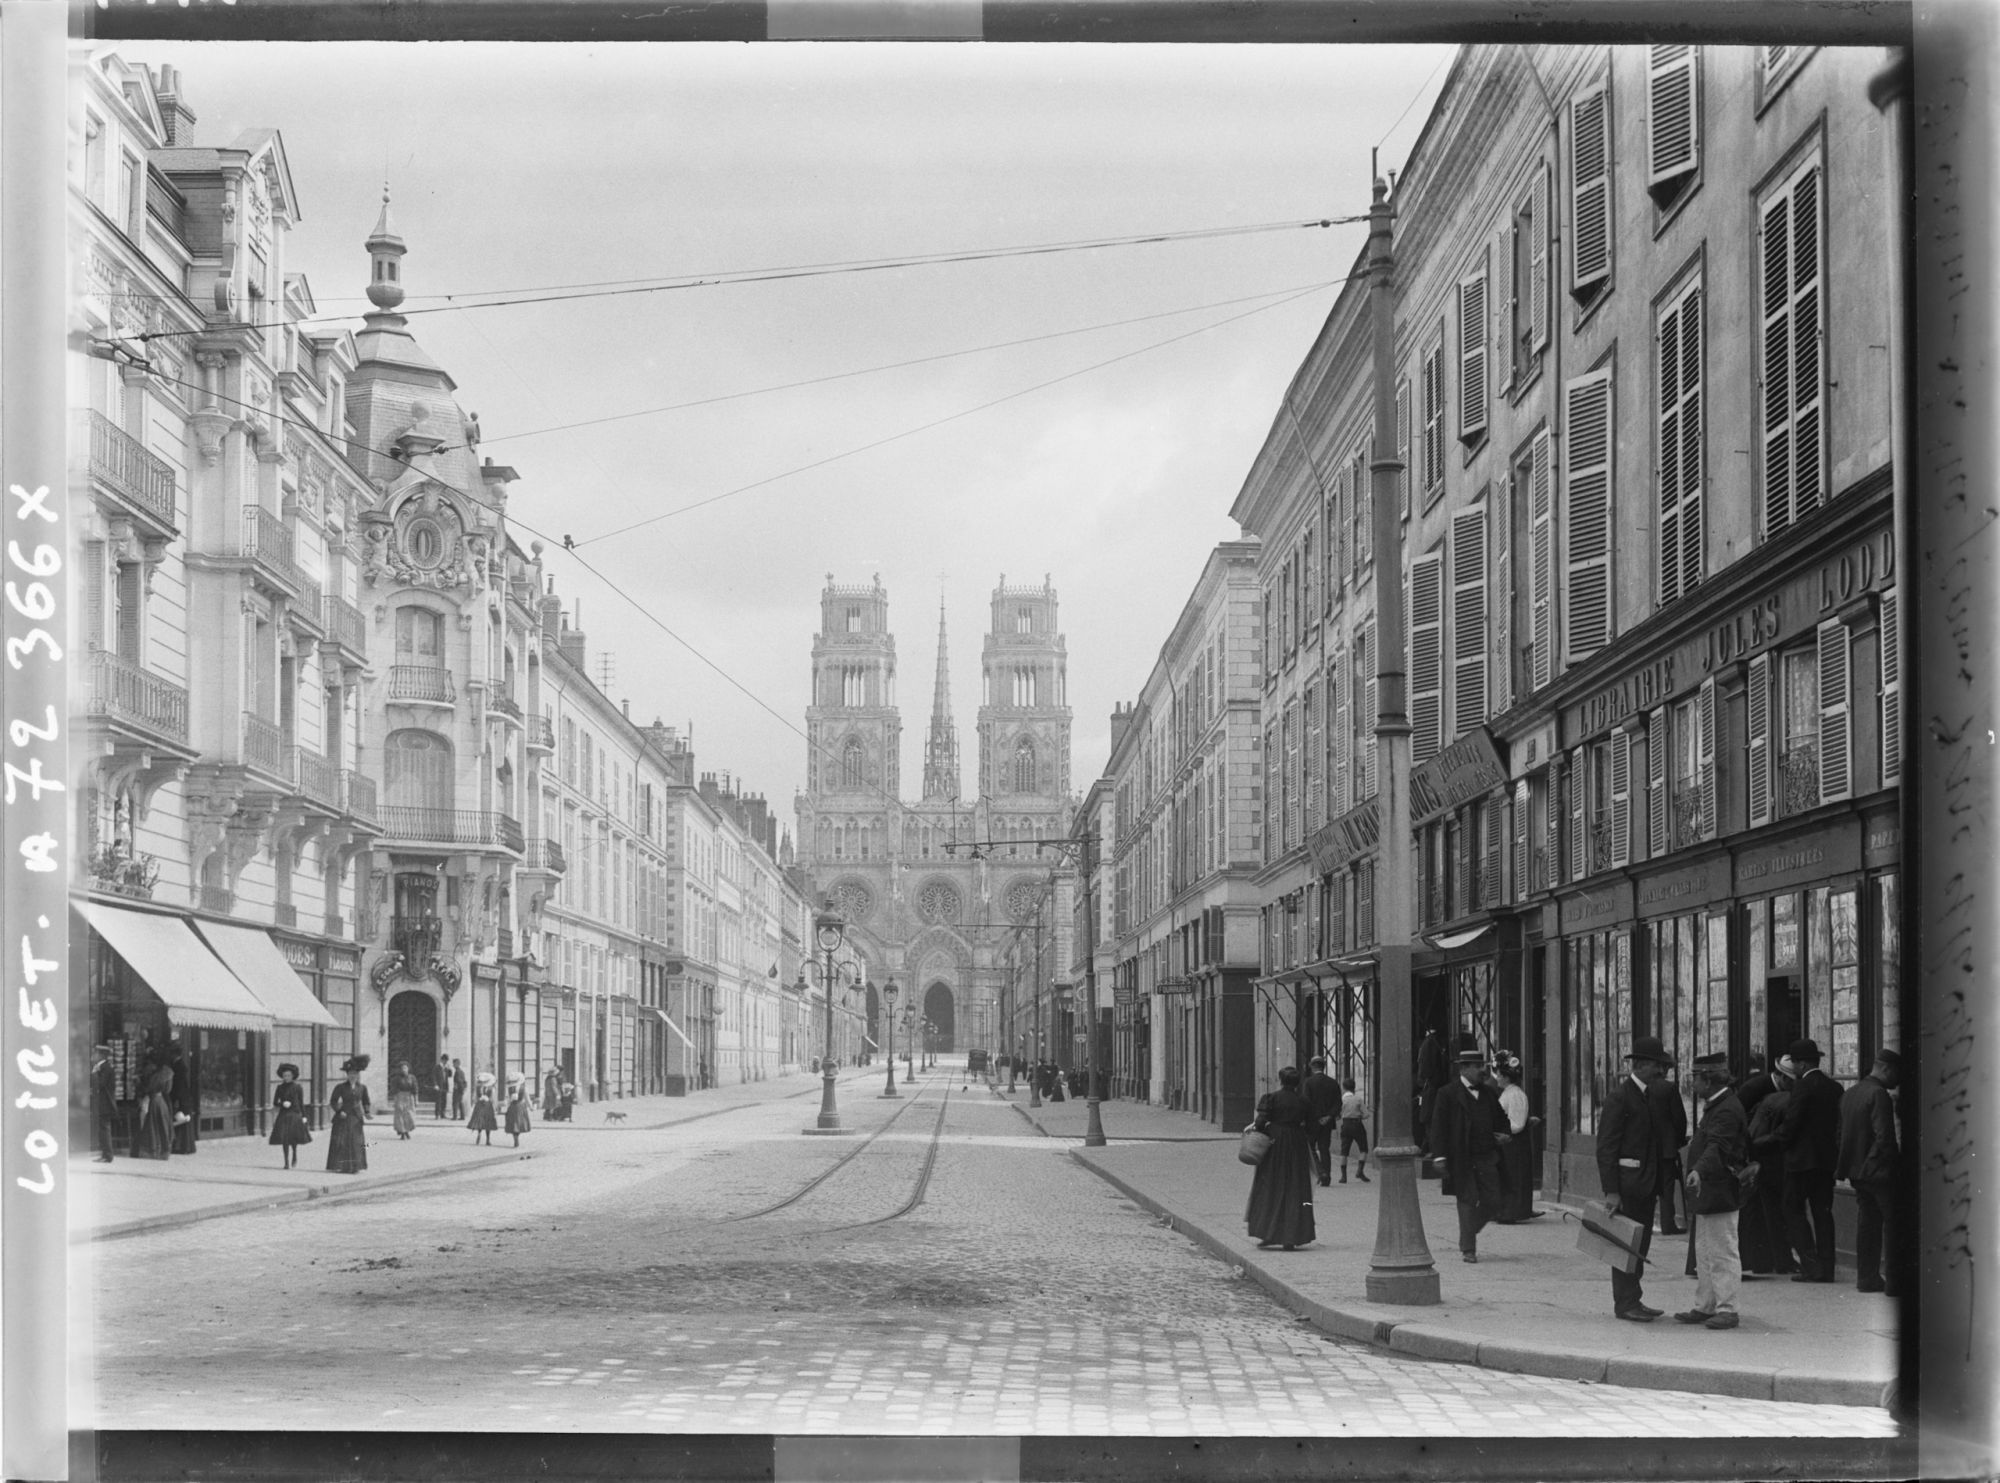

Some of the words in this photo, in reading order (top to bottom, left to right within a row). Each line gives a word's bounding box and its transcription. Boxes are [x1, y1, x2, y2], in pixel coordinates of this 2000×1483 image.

[1579, 655, 1674, 738] LIBRAIRIE
[1702, 593, 1781, 673] JULES
[1818, 531, 1894, 614] LODD
[403, 878, 439, 890] PIANOS
